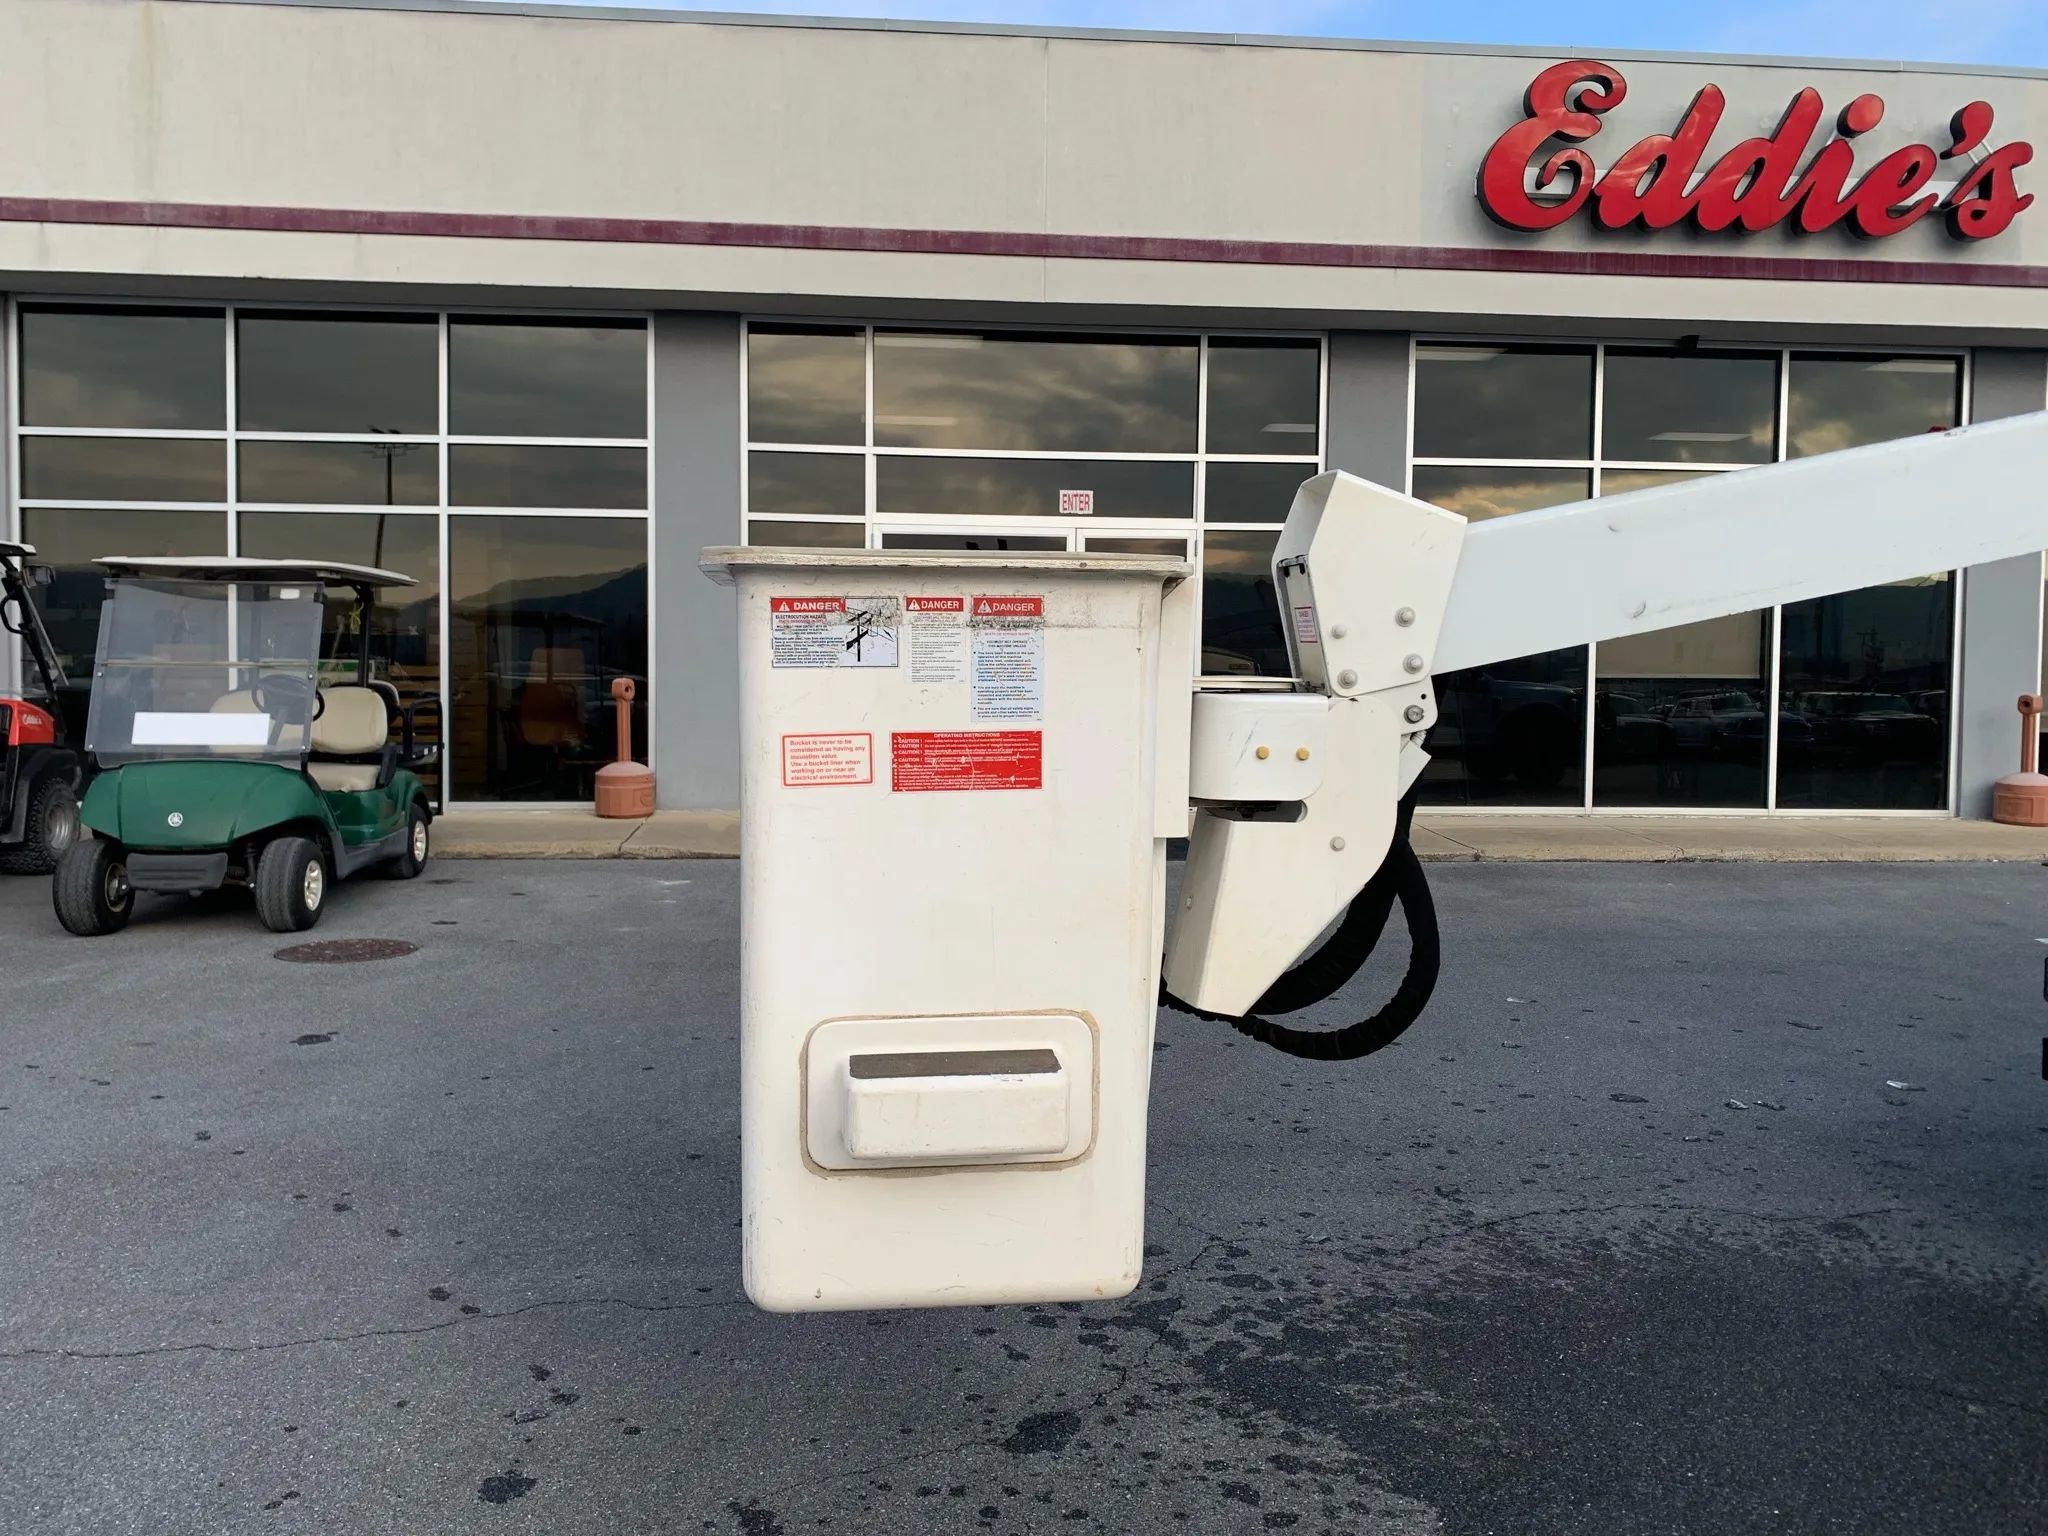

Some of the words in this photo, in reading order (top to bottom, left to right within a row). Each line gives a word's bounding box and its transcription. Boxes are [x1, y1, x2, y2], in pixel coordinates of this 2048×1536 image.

[1478, 59, 2035, 241] Eddie's
[1062, 493, 1090, 511] ENTER
[793, 602, 840, 610] DANGER
[920, 600, 960, 609] DANGER
[992, 602, 1035, 612] DANGER
